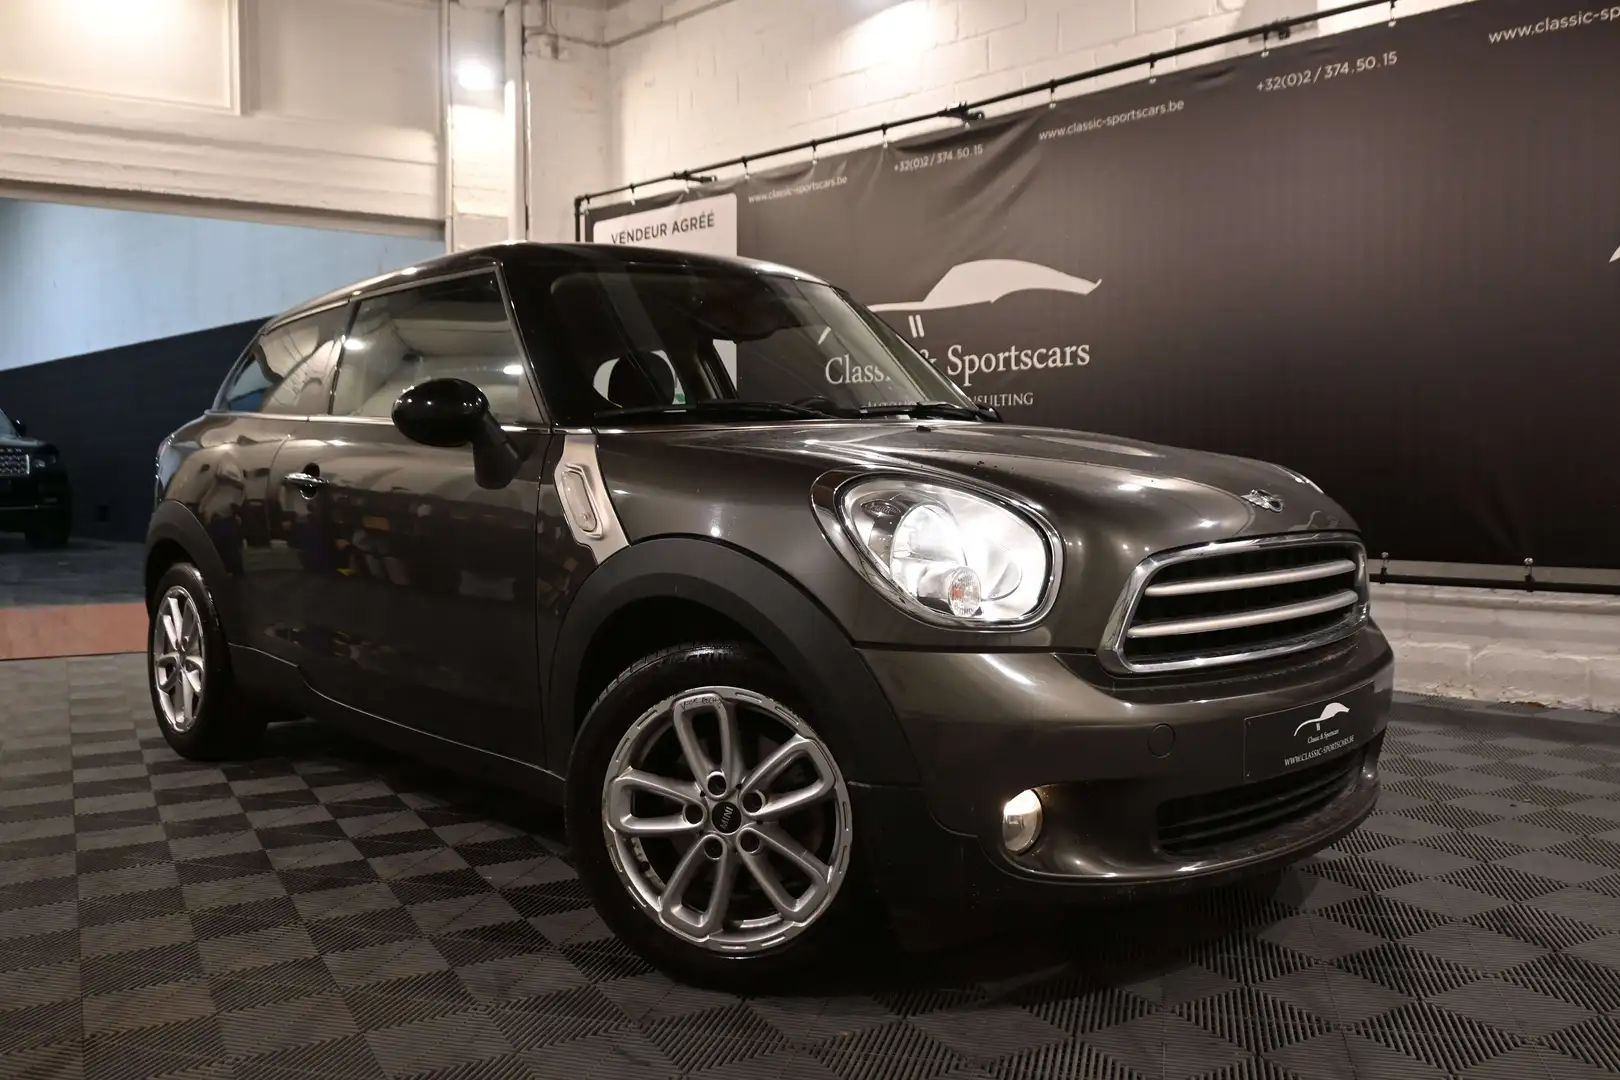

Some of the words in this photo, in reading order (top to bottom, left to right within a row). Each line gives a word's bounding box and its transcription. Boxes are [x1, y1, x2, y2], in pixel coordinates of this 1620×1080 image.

[1038, 99, 1185, 141] www.classic-sportscars.be
[611, 223, 667, 244] VENDEUR
[672, 209, 715, 235] AGRÉÉ
[825, 353, 892, 385] Class
[947, 344, 1090, 387] Sportscars
[720, 806, 734, 829] MINI
